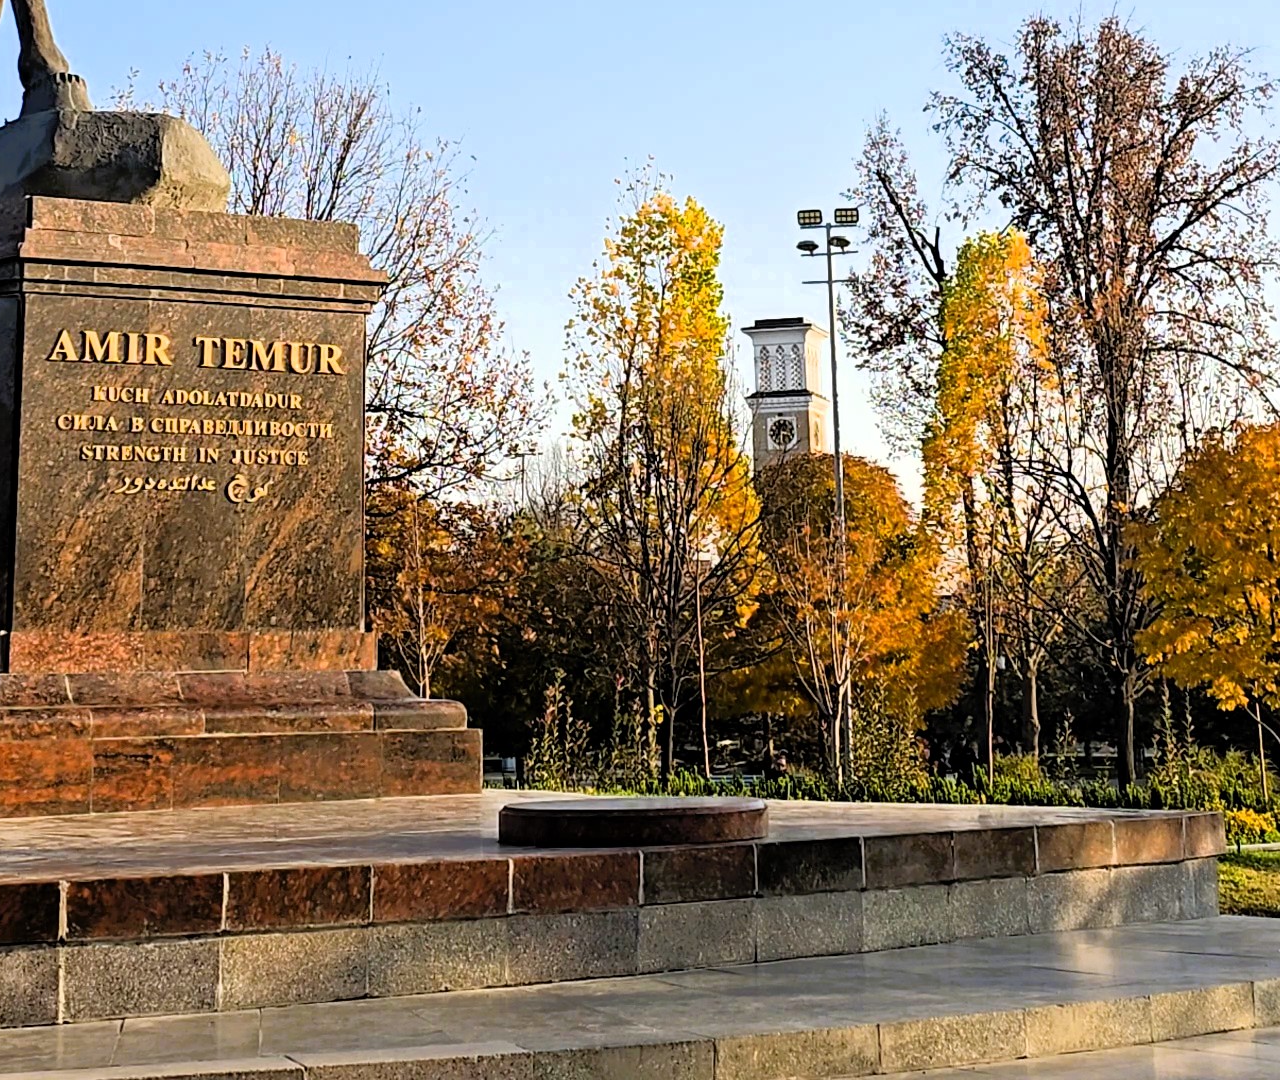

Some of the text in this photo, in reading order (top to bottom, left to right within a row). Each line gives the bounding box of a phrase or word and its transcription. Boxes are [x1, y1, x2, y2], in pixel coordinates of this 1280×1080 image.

[47, 328, 345, 375] AMIR TEMUR
[92, 386, 302, 410] KUCH ADOLATDADUR
[57, 414, 333, 438] СИЛА В СПРАВЕДЛИВОСТИ
[81, 445, 308, 466] STRENGTH IN JUSTICE
